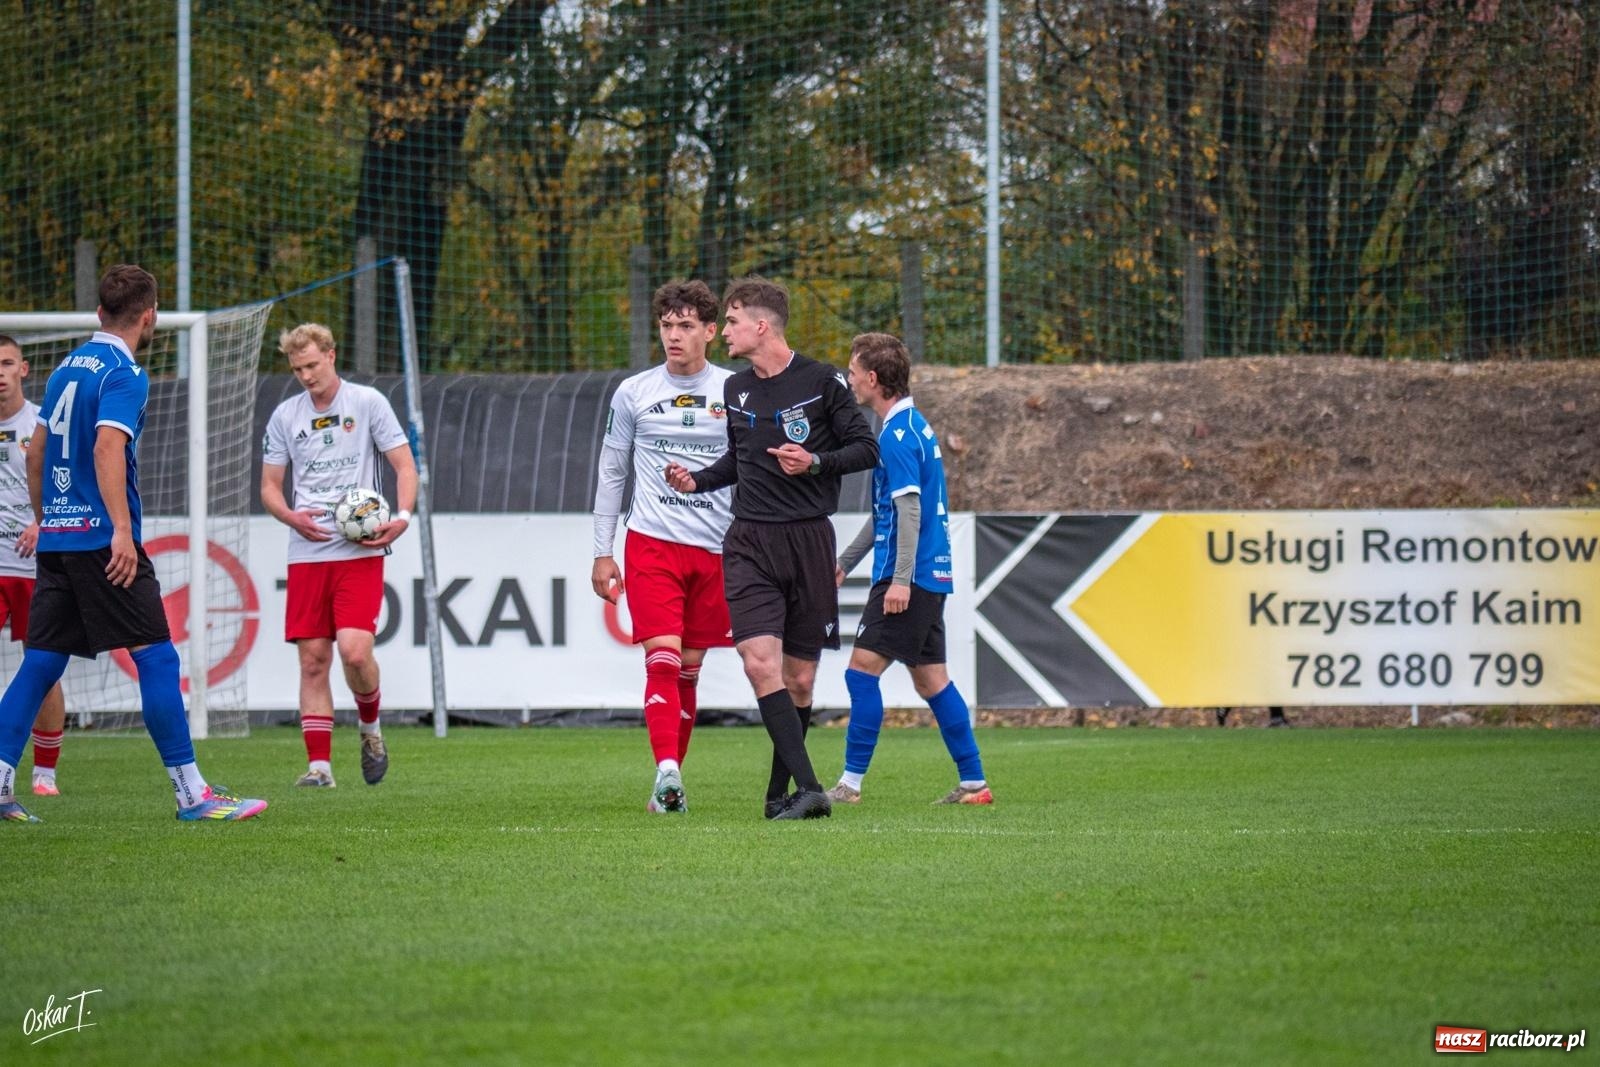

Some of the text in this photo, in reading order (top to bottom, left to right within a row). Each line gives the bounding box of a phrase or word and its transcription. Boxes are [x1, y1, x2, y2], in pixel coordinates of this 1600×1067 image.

[48, 381, 78, 459] 4
[53, 497, 68, 505] MB
[1206, 529, 1345, 572] Usługi
[1249, 590, 1583, 634] Krzysztof Kaim
[1287, 653, 1545, 688] 782 680 799
